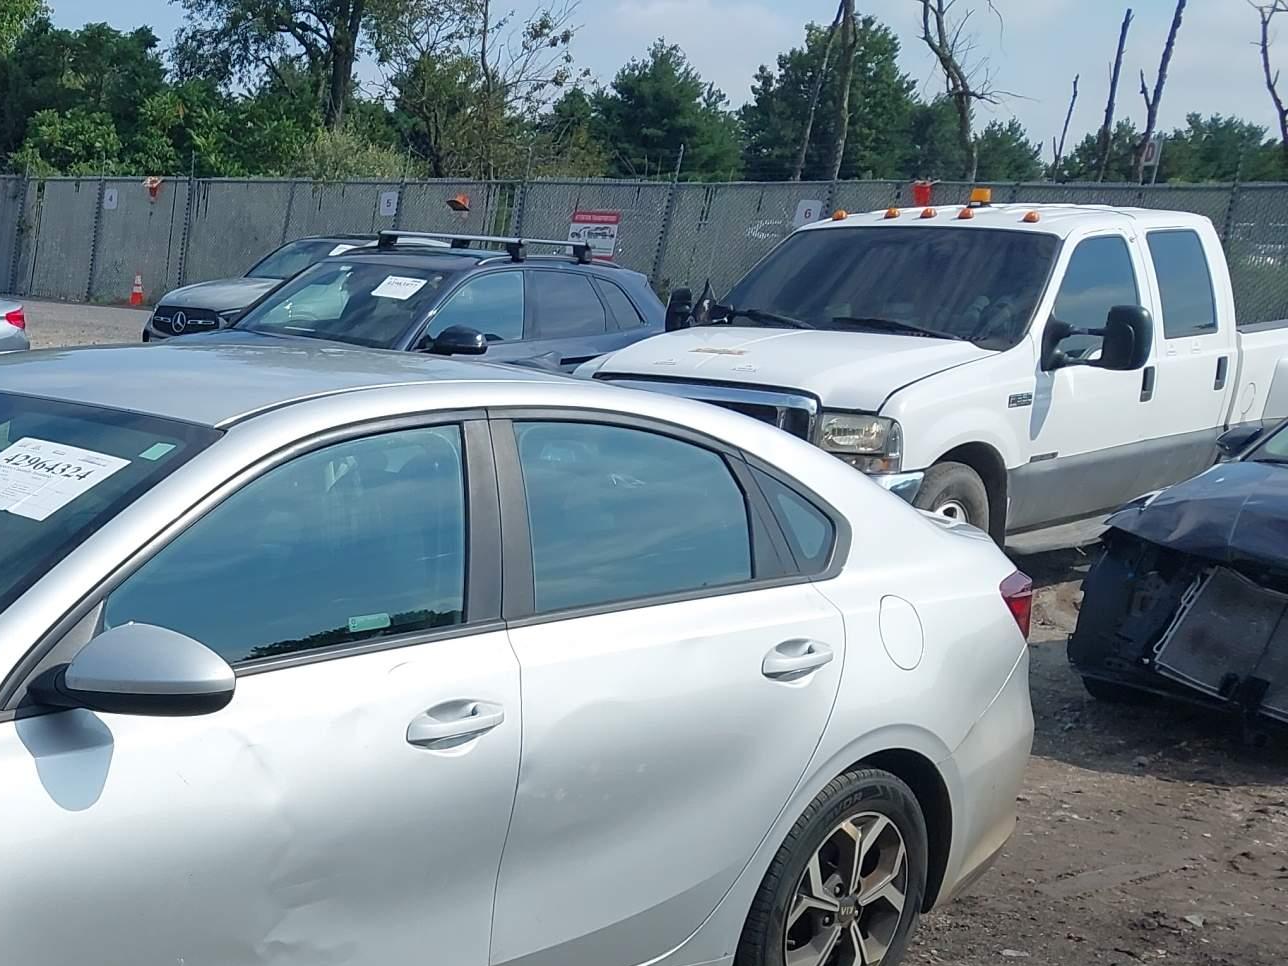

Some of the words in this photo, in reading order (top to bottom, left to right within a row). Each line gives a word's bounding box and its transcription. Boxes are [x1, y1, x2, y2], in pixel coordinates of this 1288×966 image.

[386, 198, 392, 208] 5
[804, 208, 812, 219] 6
[4, 453, 95, 480] 42964324
